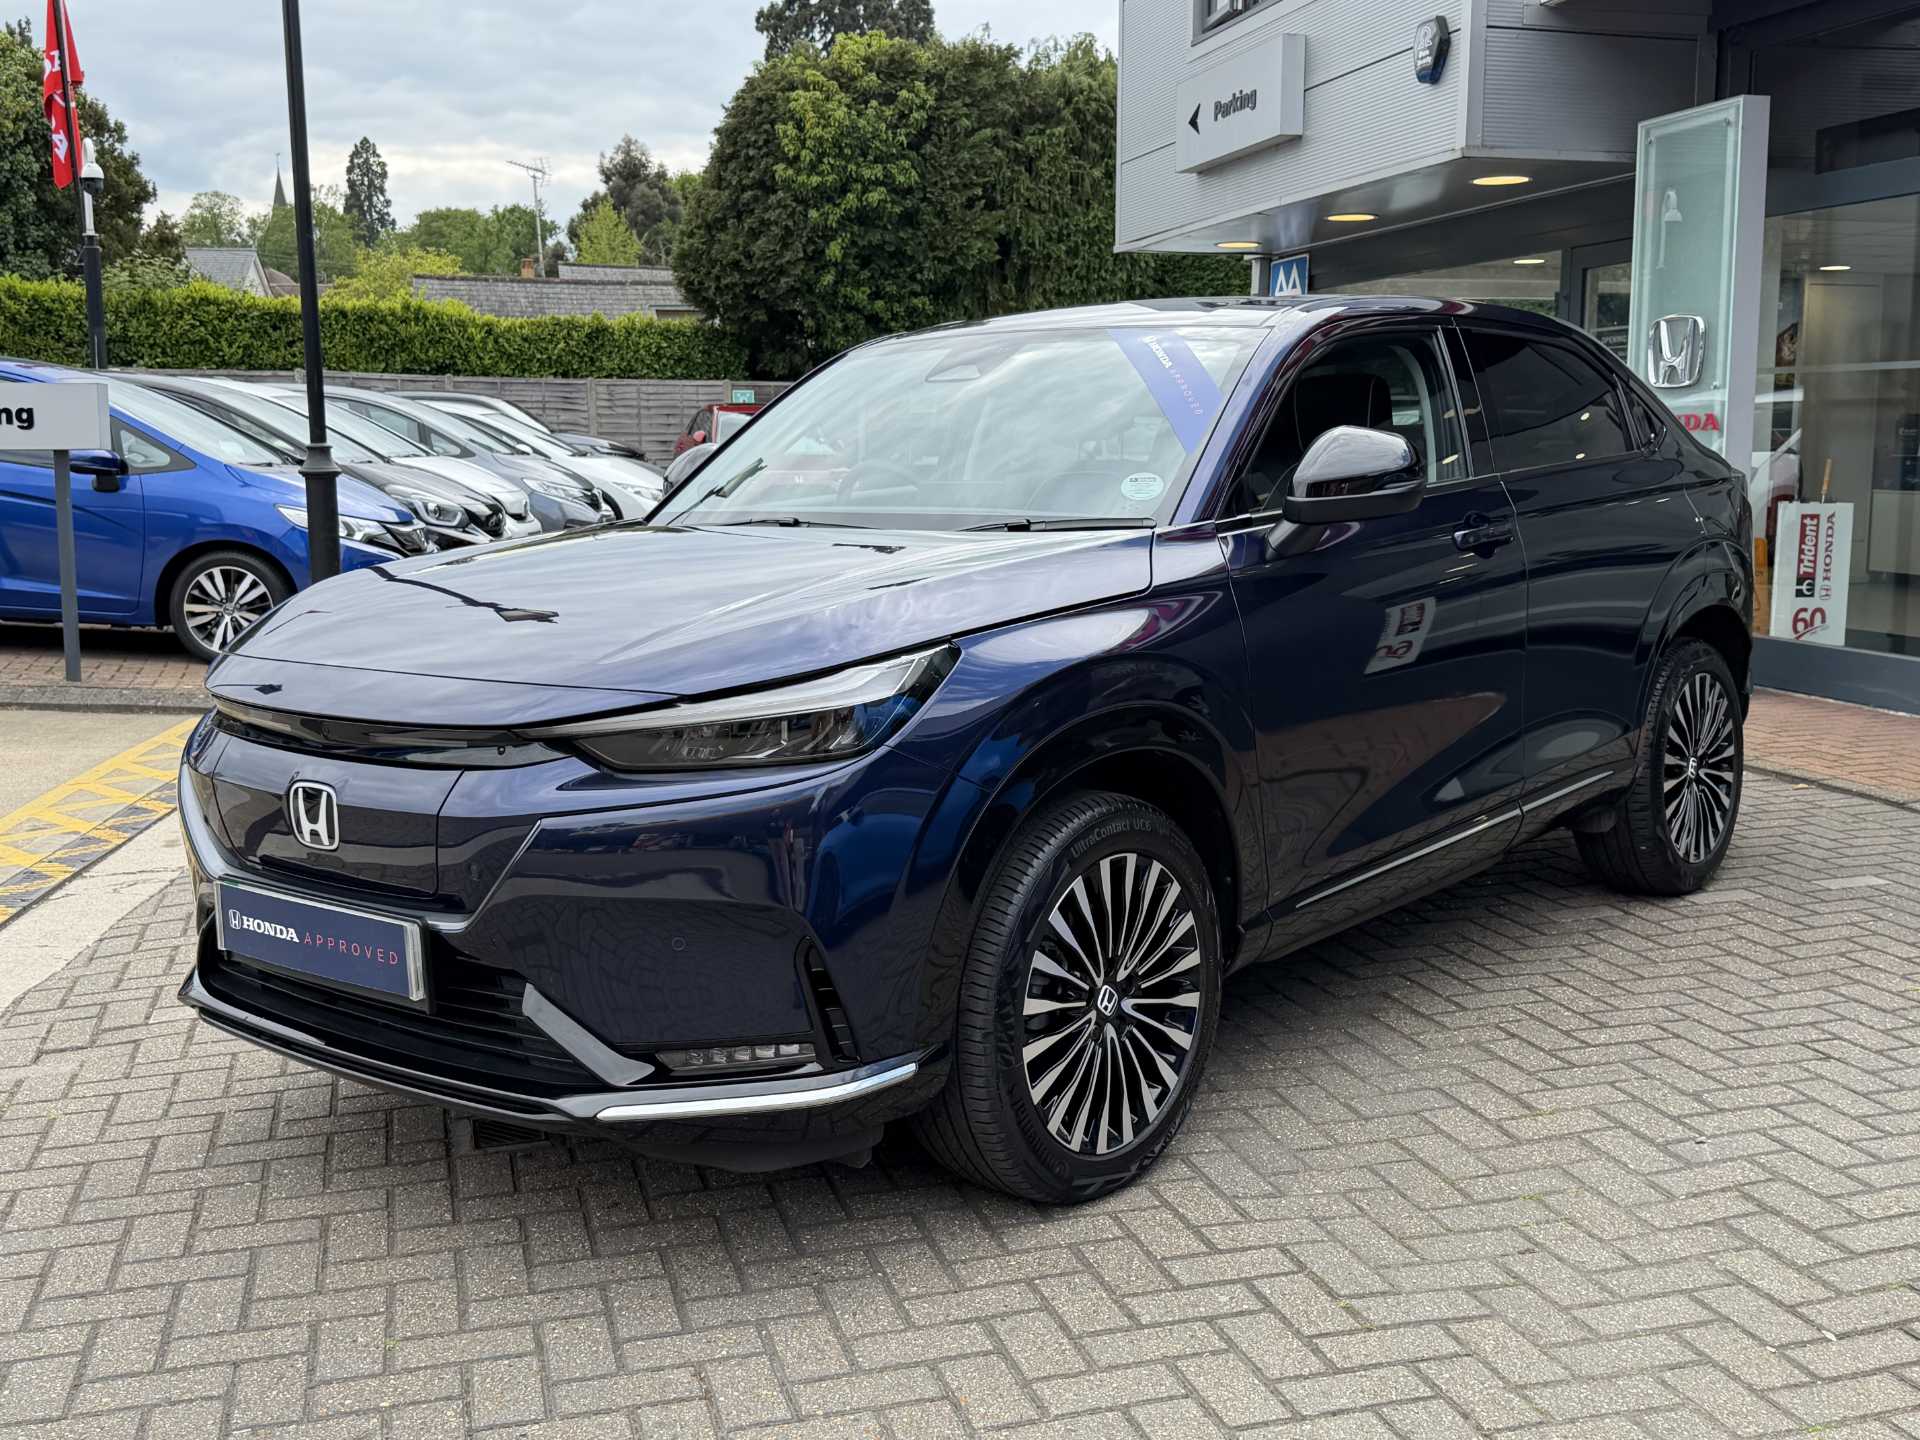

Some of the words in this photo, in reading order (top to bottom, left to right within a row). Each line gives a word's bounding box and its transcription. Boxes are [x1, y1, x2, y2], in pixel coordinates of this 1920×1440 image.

[1213, 88, 1257, 121] Parking
[0, 406, 35, 431] ng
[1677, 412, 1720, 431] DA
[1800, 517, 1818, 576] Trident
[1822, 511, 1836, 582] HONDA
[1792, 607, 1827, 638] 60
[1070, 820, 1131, 858] UltraContact
[1133, 819, 1152, 832] UC6
[242, 915, 300, 943] HONDA
[304, 932, 399, 965] APPROVED
